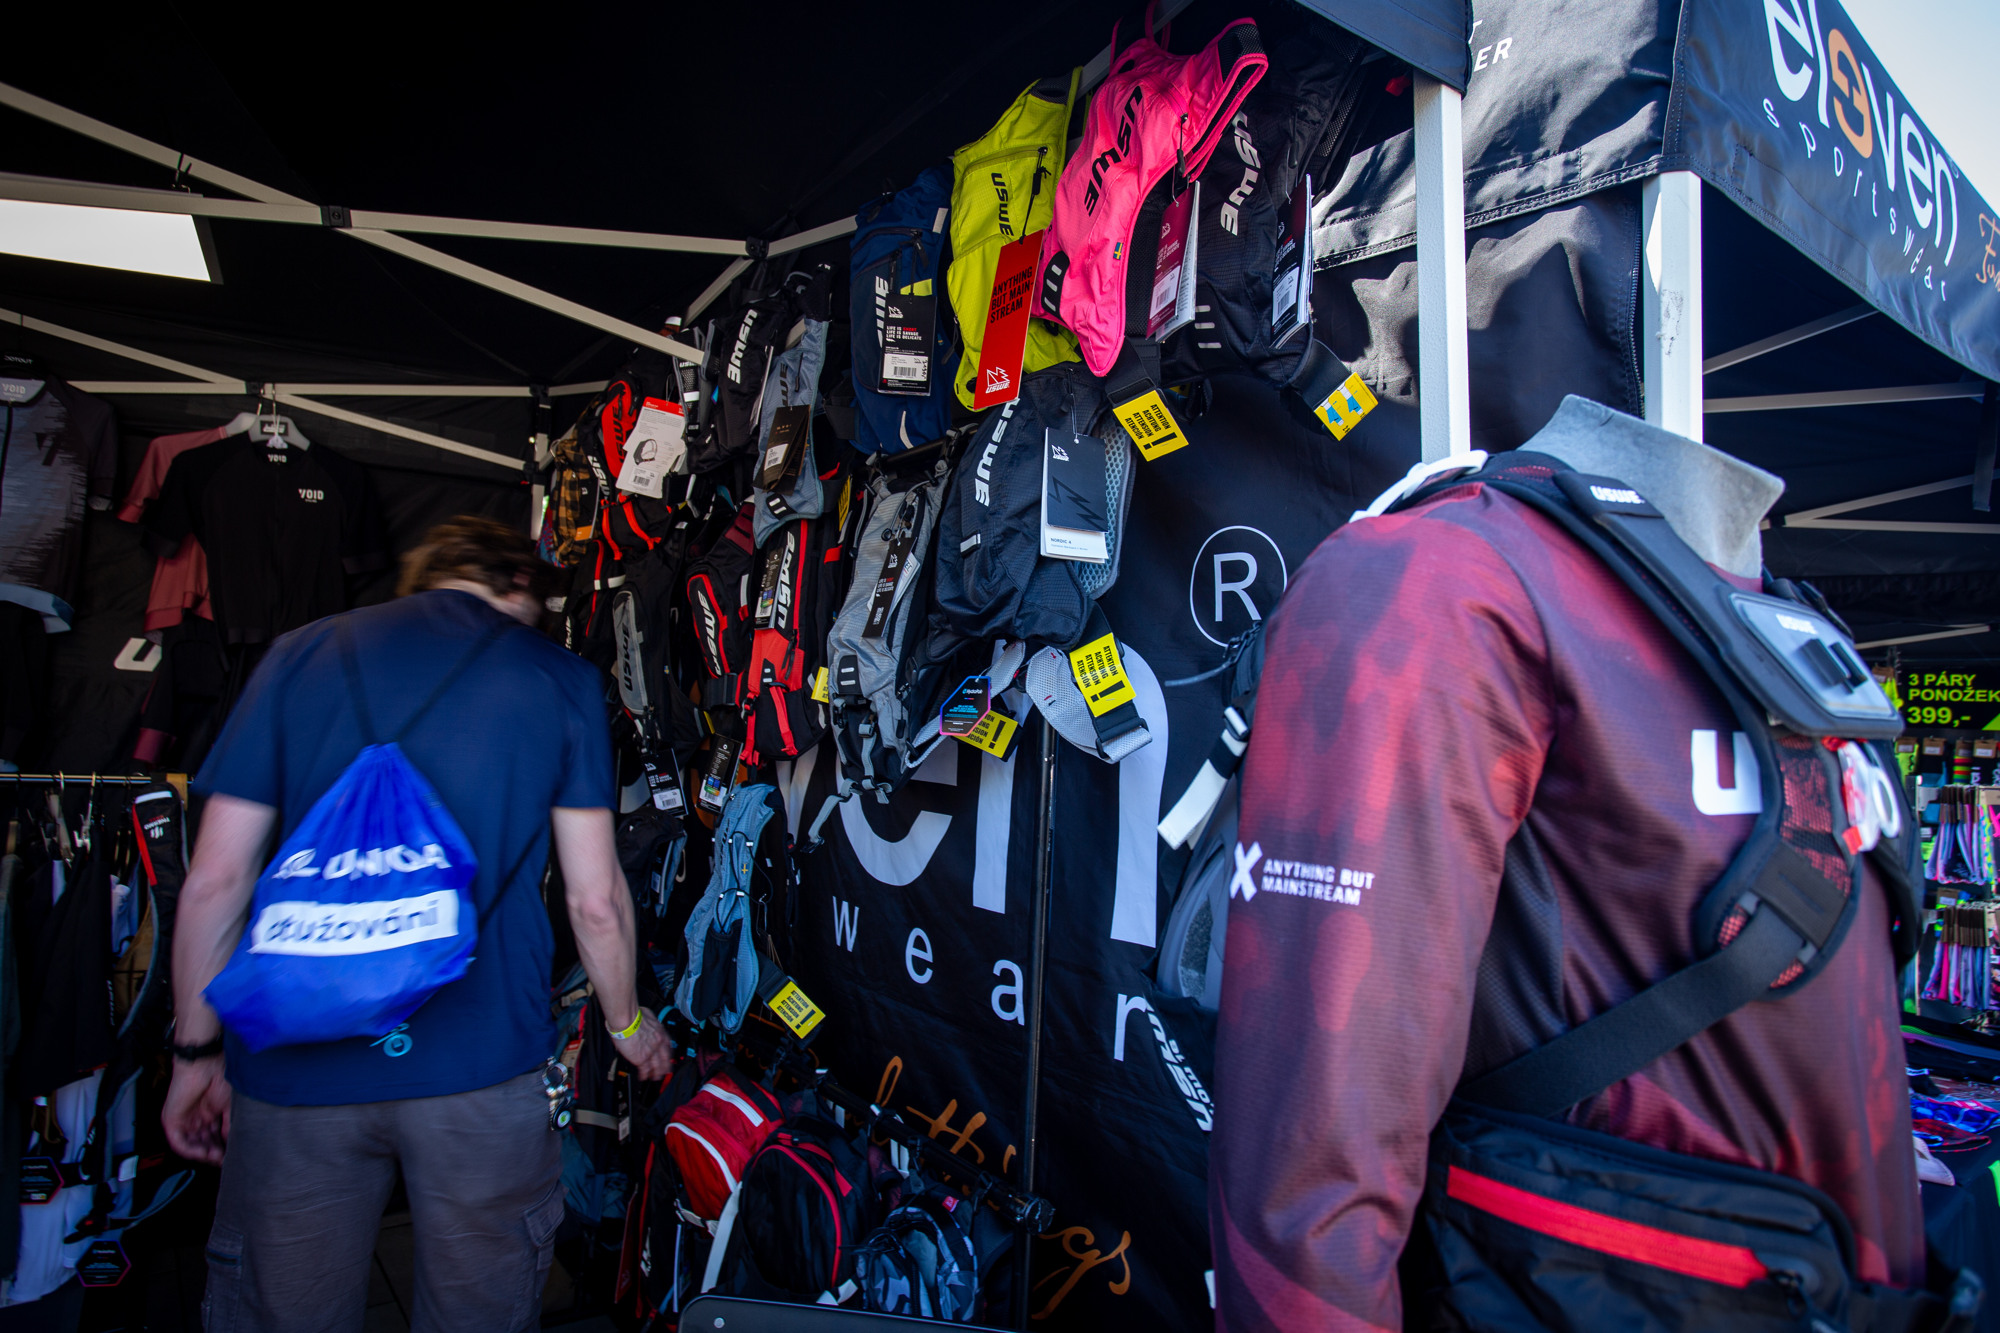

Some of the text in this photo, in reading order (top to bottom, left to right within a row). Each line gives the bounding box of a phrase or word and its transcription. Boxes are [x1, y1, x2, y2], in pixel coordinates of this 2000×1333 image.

[1084, 86, 1143, 217] USWE
[991, 172, 1014, 238] USWE
[1763, 97, 1947, 302] sportswear
[991, 280, 1035, 311] BUT MAIN-
[992, 266, 1033, 299] ANYTHING
[990, 297, 1023, 324] STREAM
[727, 309, 758, 385] USWE
[1, 383, 26, 394] VOID
[986, 382, 1010, 394] USWE
[1125, 417, 1145, 440] ATENCIÓN
[1133, 412, 1154, 437] ATTENSION
[1142, 409, 1161, 432] ACHTUNG
[1150, 404, 1171, 430] ATTENTION
[267, 453, 288, 463] VOID
[975, 398, 1020, 507] USWE
[298, 488, 325, 501] VOID
[777, 531, 795, 630] USWE
[698, 590, 722, 676] USWE
[1077, 660, 1092, 688] ATENCIÓN
[1085, 654, 1101, 686] ATTENSION
[1094, 651, 1108, 679] ACHTUNG
[1103, 645, 1119, 676] ATTENTION
[1907, 670, 1977, 687] 3 PÁRY
[1907, 686, 2000, 702] PONOŽEK
[1906, 706, 1972, 728] 399,-
[1263, 858, 1376, 890] ANYTHING BUT
[1261, 875, 1362, 906] MAINSTREAM
